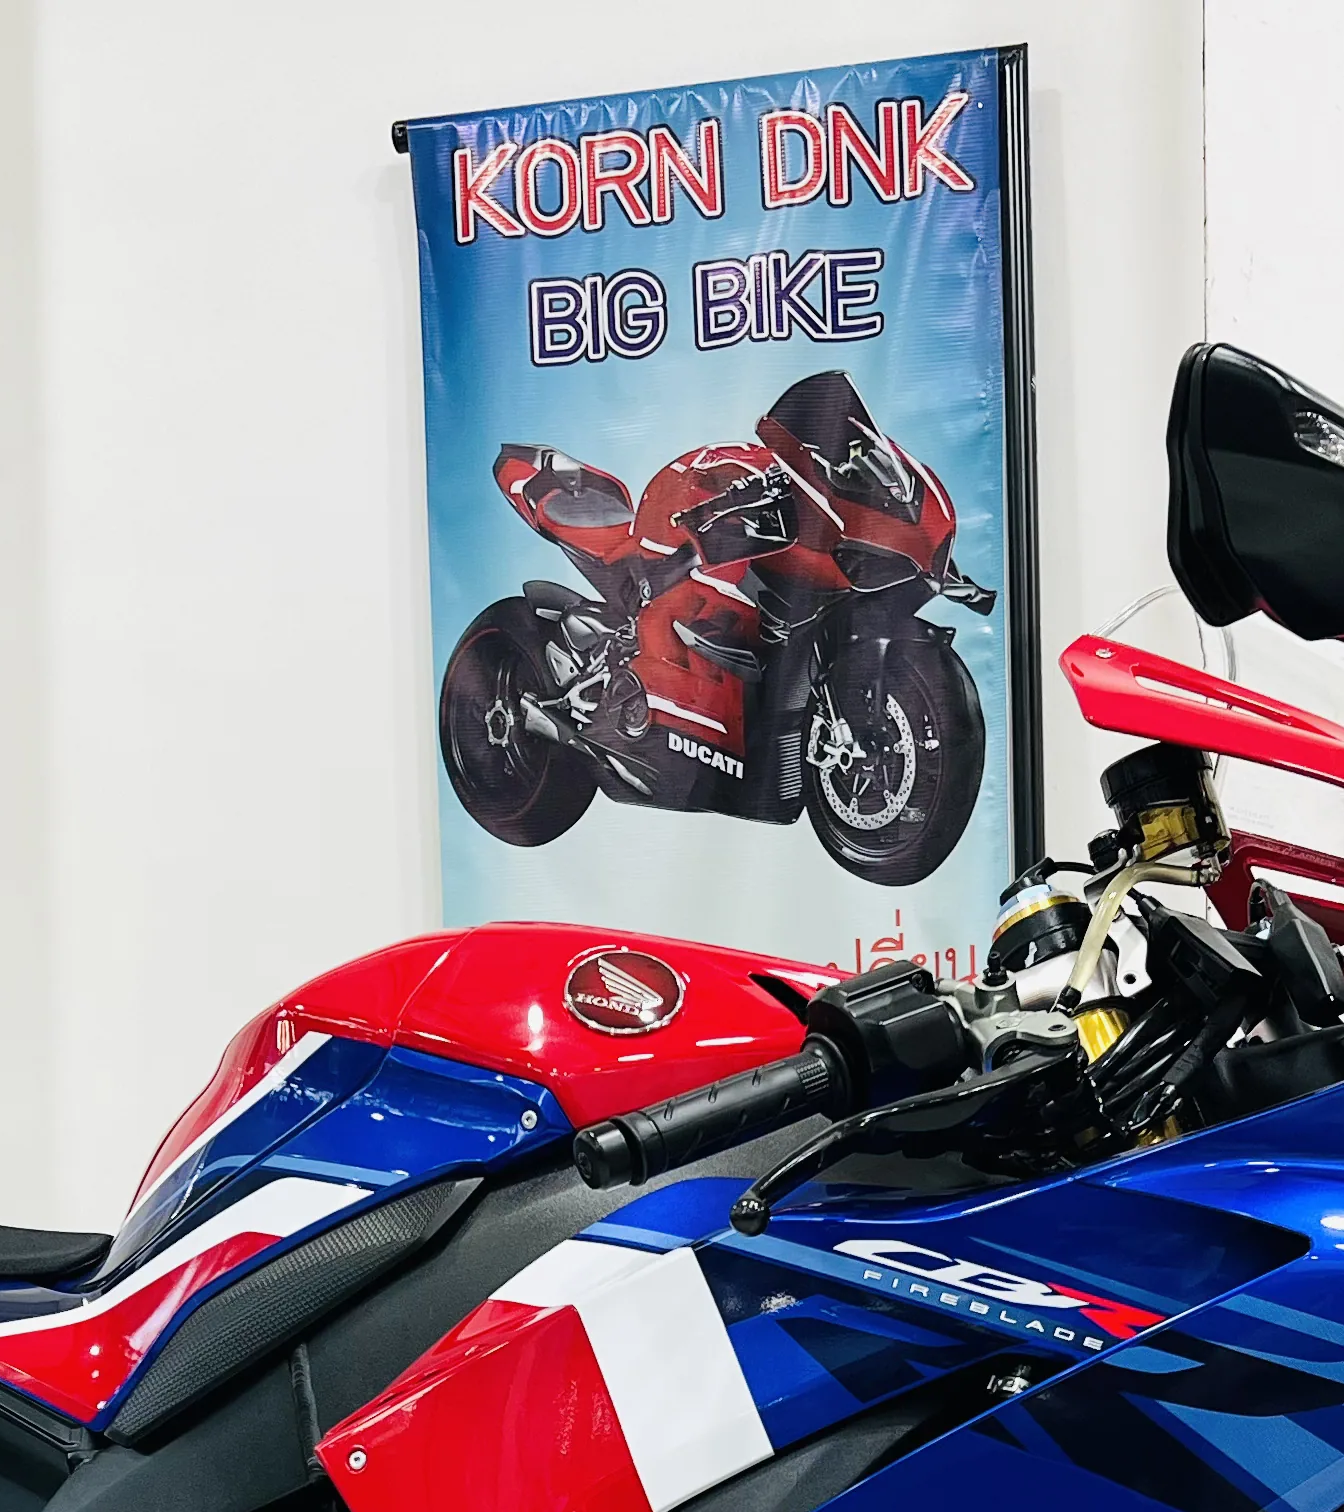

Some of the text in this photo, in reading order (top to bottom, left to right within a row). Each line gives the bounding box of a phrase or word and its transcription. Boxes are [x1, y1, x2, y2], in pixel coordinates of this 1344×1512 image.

[453, 91, 975, 245] KORN DNK
[530, 249, 884, 366] BIG BIKE
[668, 732, 744, 780] DUCATI
[575, 993, 646, 1018] HOND
[863, 1269, 1104, 1350] FIREBLADE
